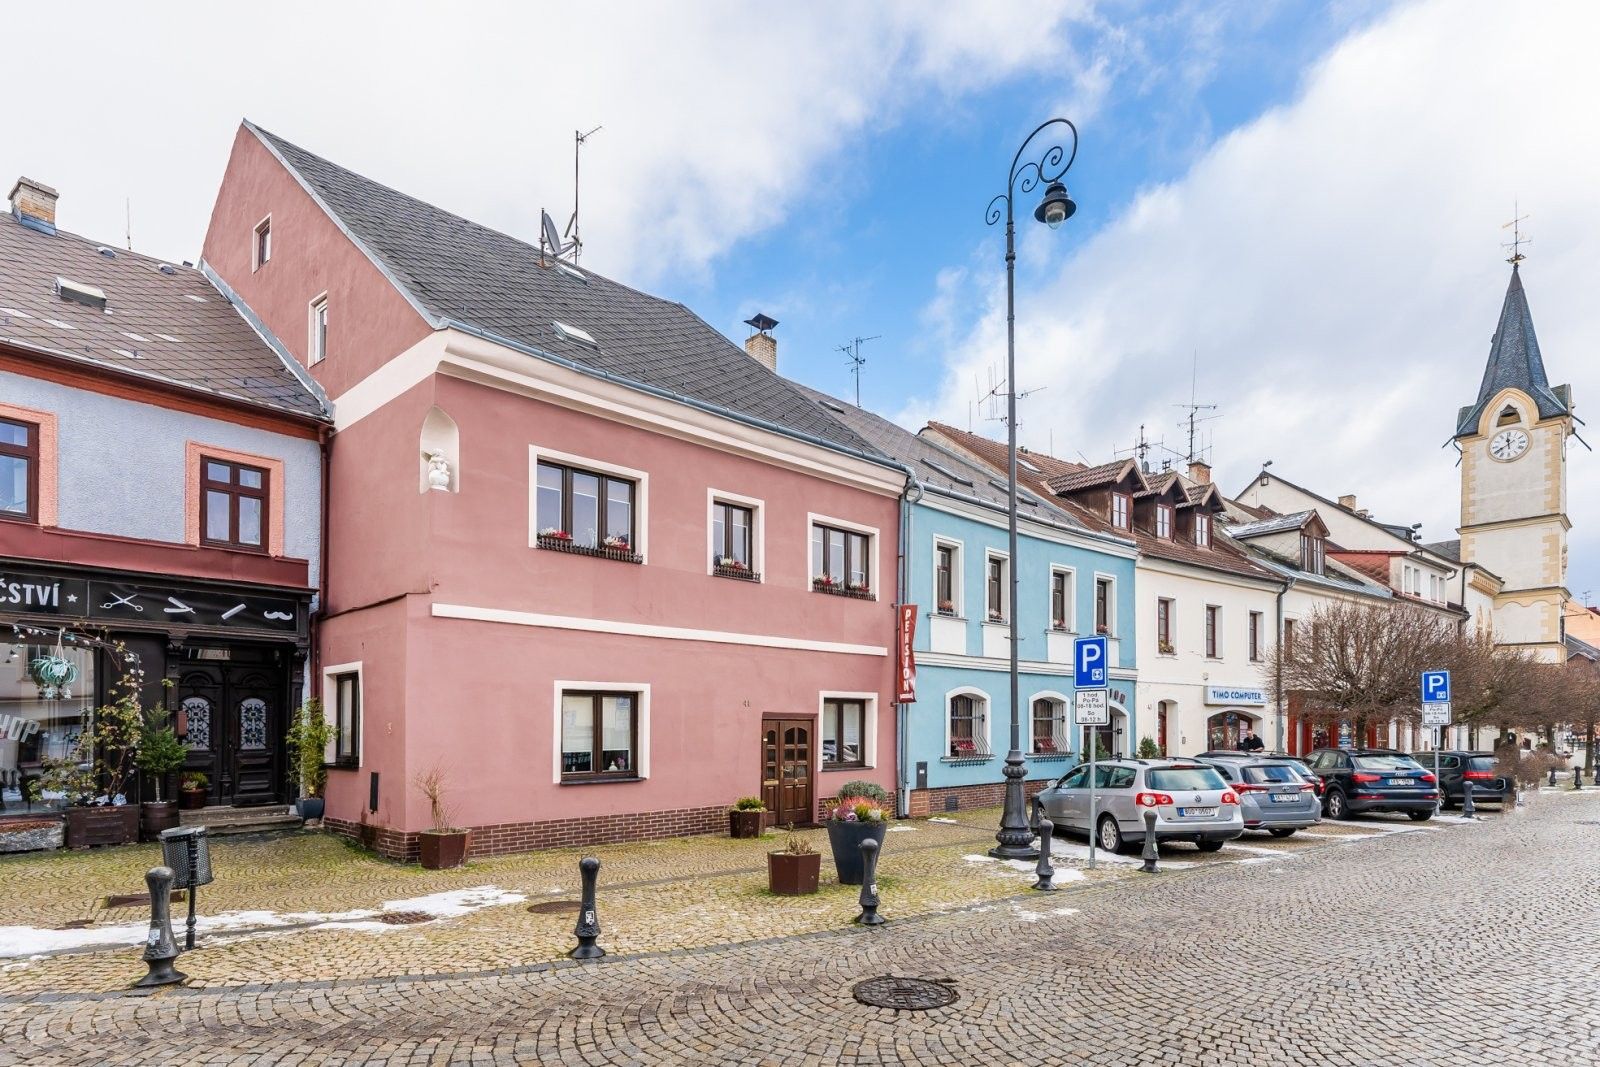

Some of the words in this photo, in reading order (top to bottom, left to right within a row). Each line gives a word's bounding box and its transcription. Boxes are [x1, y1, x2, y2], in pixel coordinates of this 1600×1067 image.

[903, 608, 912, 692] PENSION
[1082, 644, 1101, 673] P
[1212, 690, 1230, 699] TIMO
[1231, 691, 1262, 700] COMPUTER
[1429, 675, 1445, 693] P
